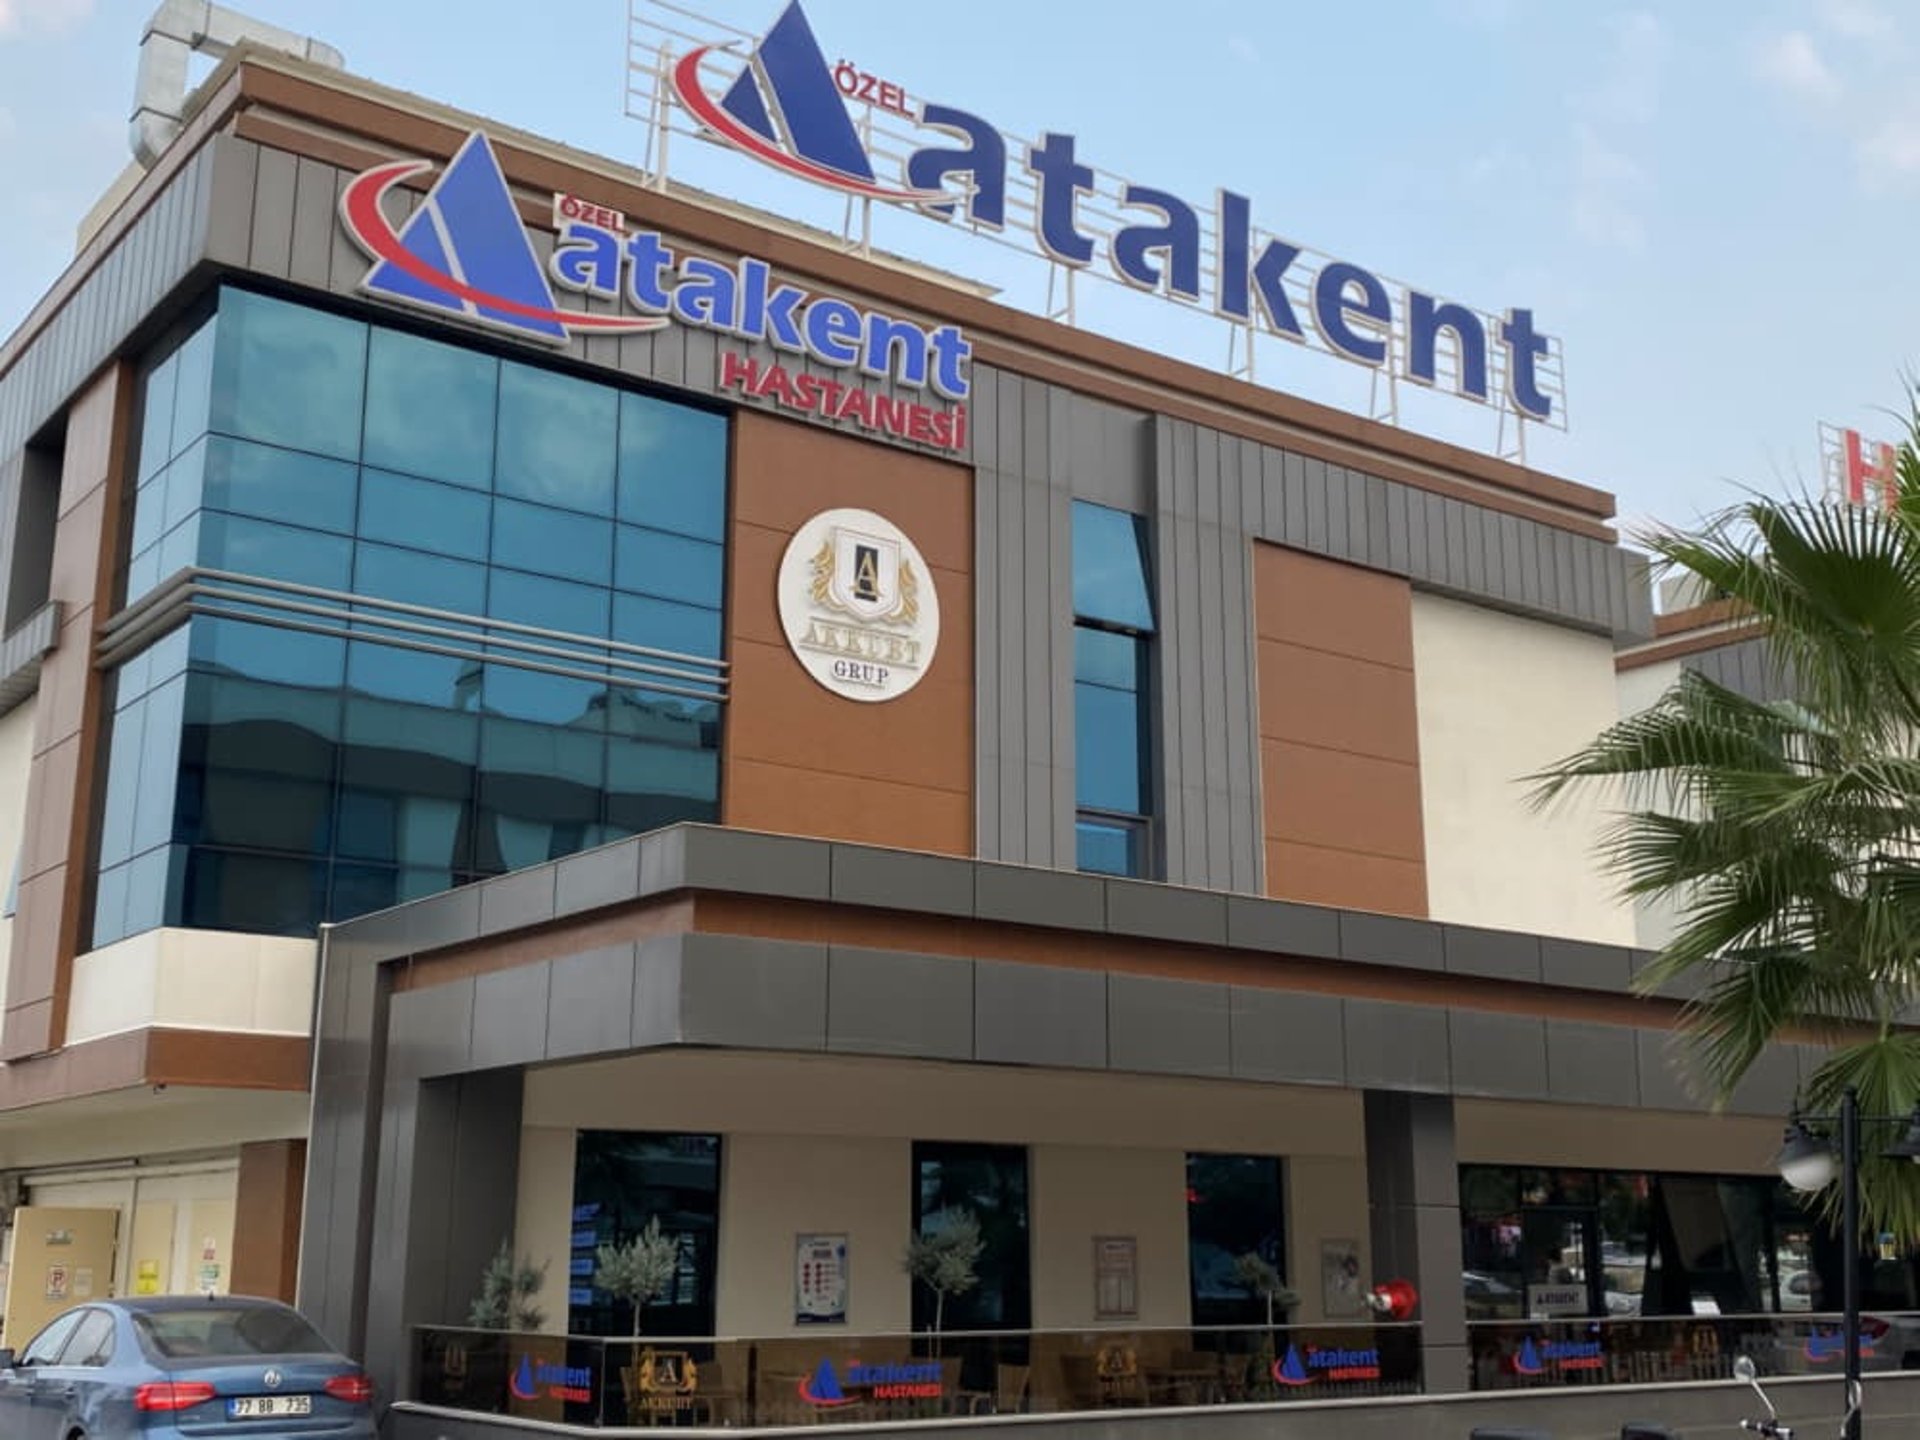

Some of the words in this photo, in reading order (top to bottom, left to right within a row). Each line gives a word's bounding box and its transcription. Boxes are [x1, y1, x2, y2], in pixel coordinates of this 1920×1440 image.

[834, 59, 916, 119] ÖZEL
[561, 193, 622, 233] ÖZEL
[903, 103, 1551, 420] atakent
[552, 223, 971, 399] atakent
[721, 353, 966, 449] HASTANESİ
[834, 660, 889, 684] GRUP
[237, 1399, 252, 1414] 77
